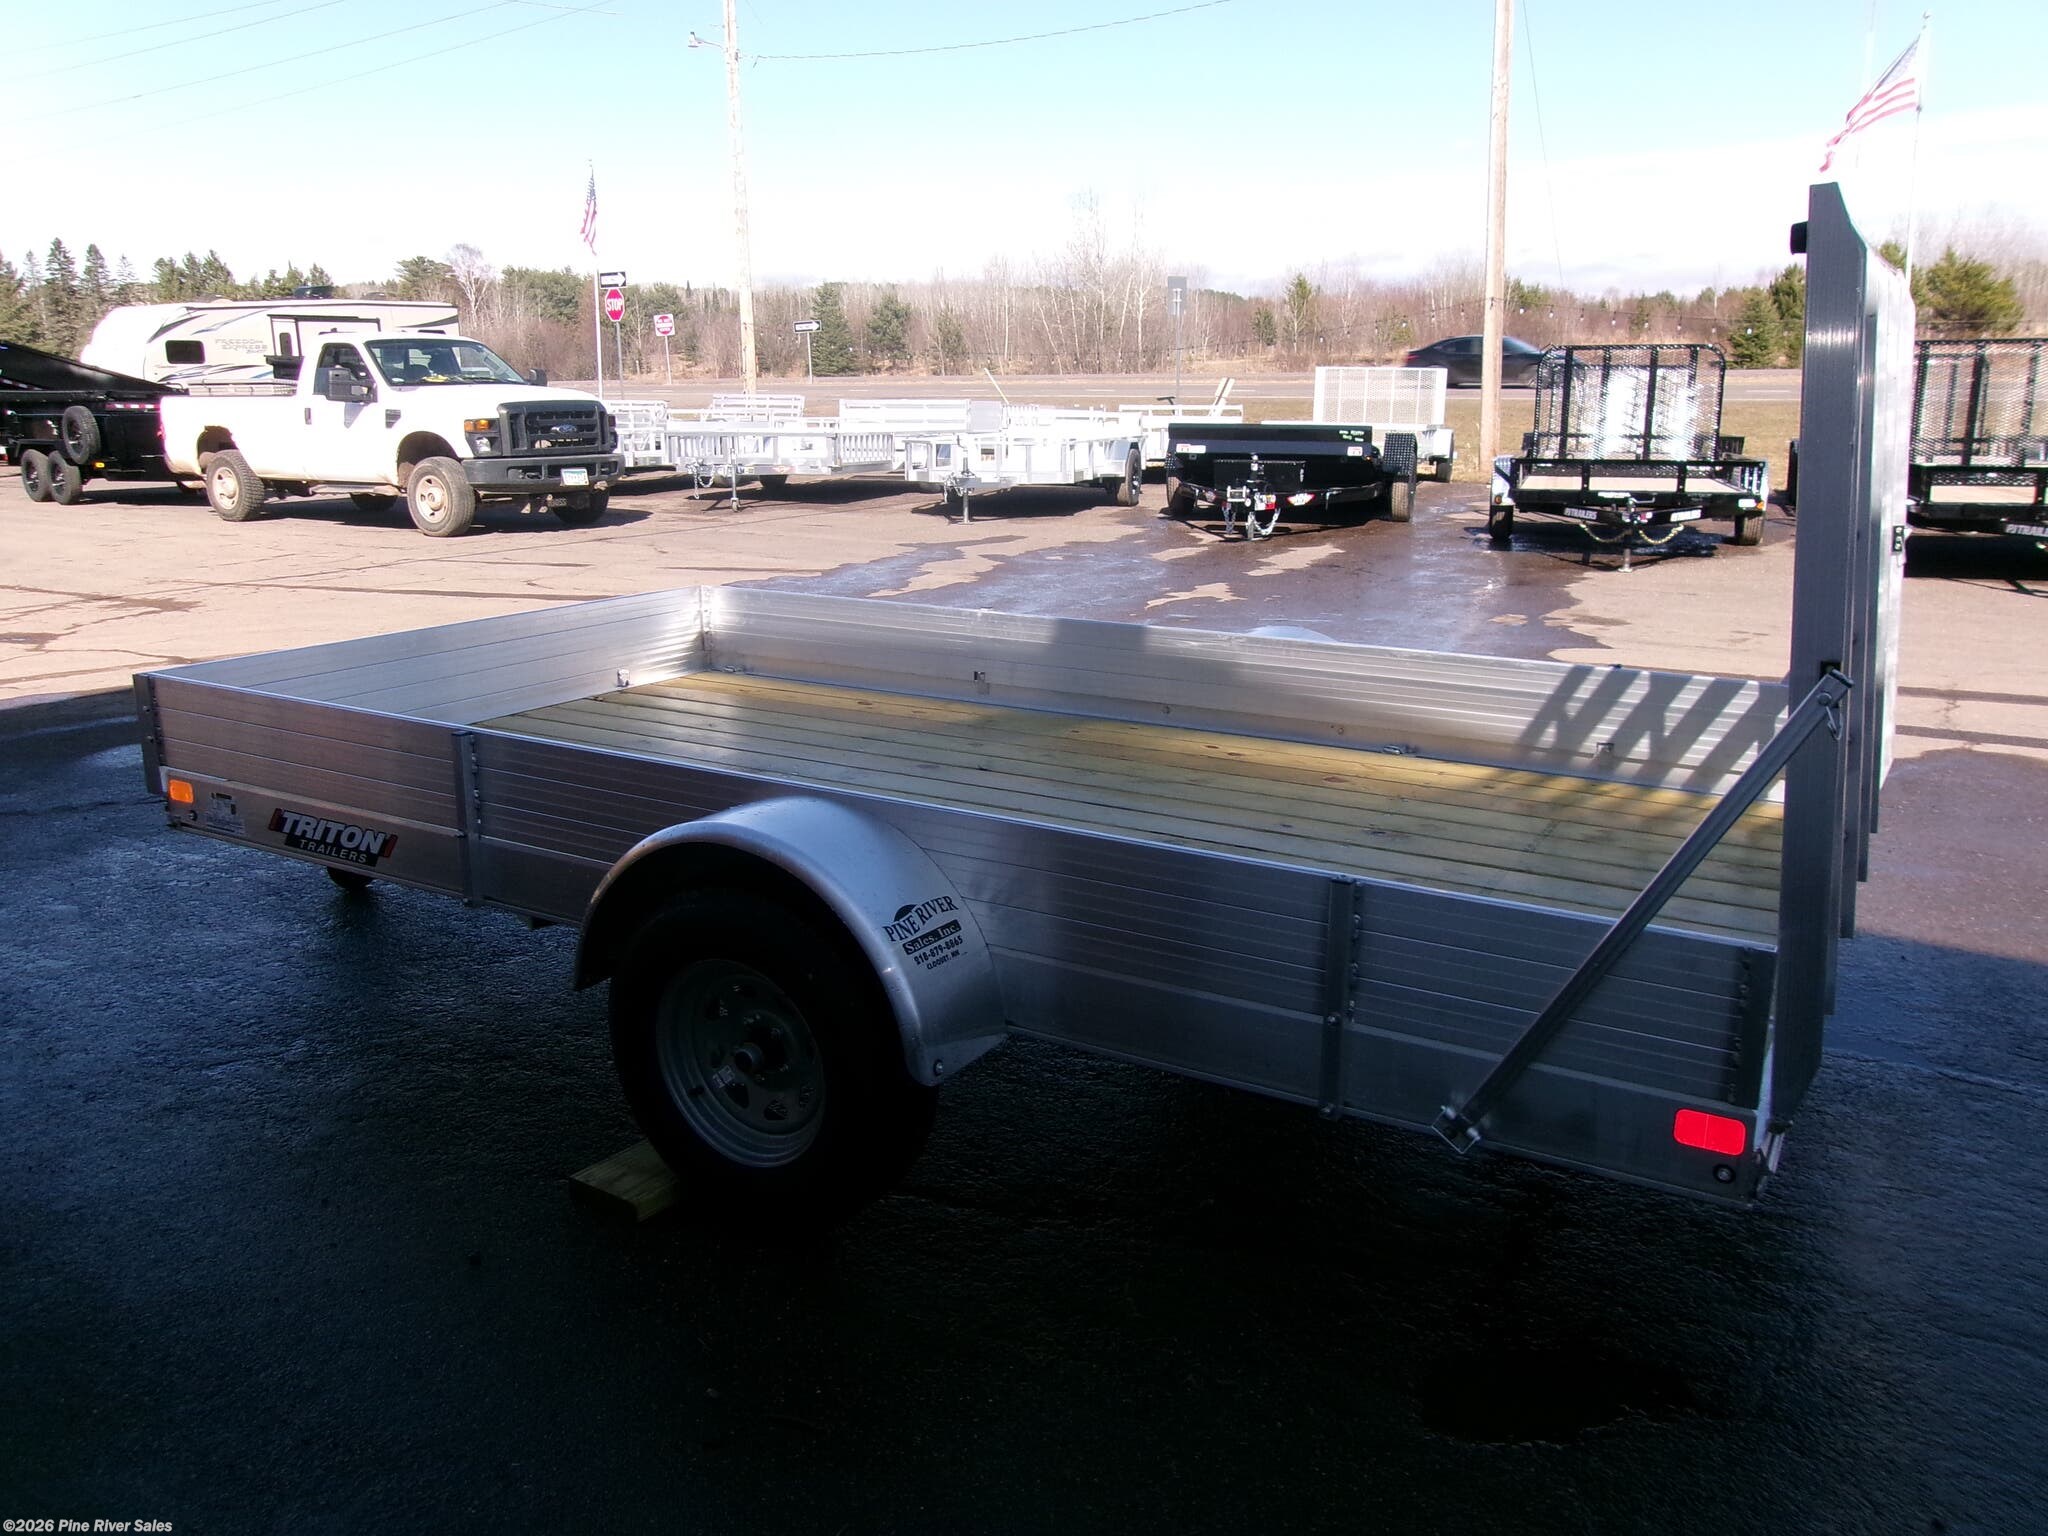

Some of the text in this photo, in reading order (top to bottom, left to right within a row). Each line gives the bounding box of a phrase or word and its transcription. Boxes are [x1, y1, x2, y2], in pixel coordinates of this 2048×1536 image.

[606, 298, 624, 312] STOP
[281, 810, 387, 855] TRITON
[299, 839, 368, 864] TRAILERS
[882, 895, 959, 942] PINE RIVER
[937, 924, 960, 938] Inc.
[913, 935, 964, 966] 218-879-8865
